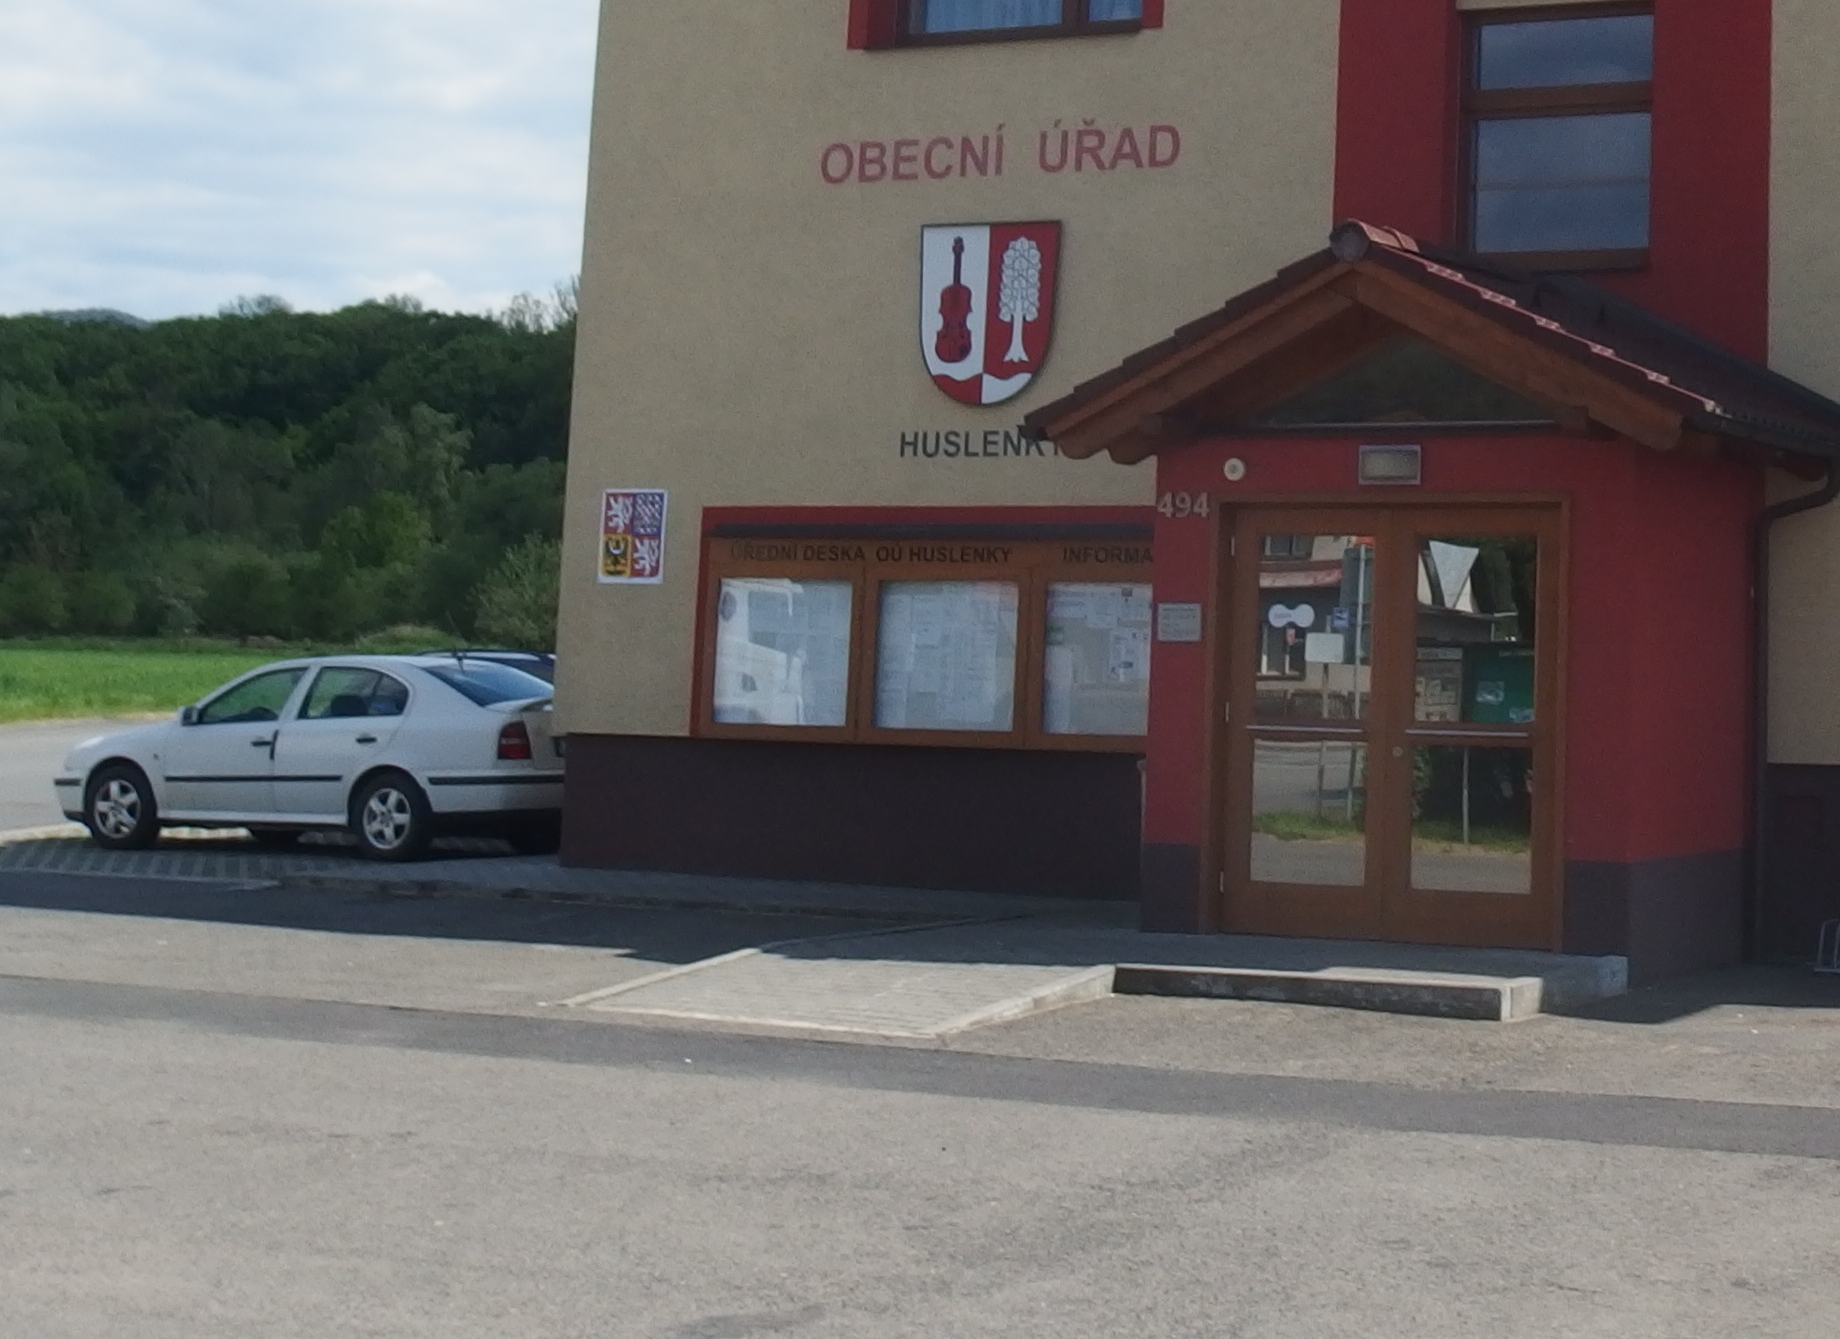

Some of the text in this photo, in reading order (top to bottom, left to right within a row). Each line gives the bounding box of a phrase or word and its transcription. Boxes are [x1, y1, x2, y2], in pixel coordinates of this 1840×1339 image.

[820, 118, 1182, 185] OBECNÍ ÚŘAD
[1156, 491, 1210, 519] 494
[803, 544, 867, 562] DESKA
[908, 545, 1012, 563] HUSLENKY
